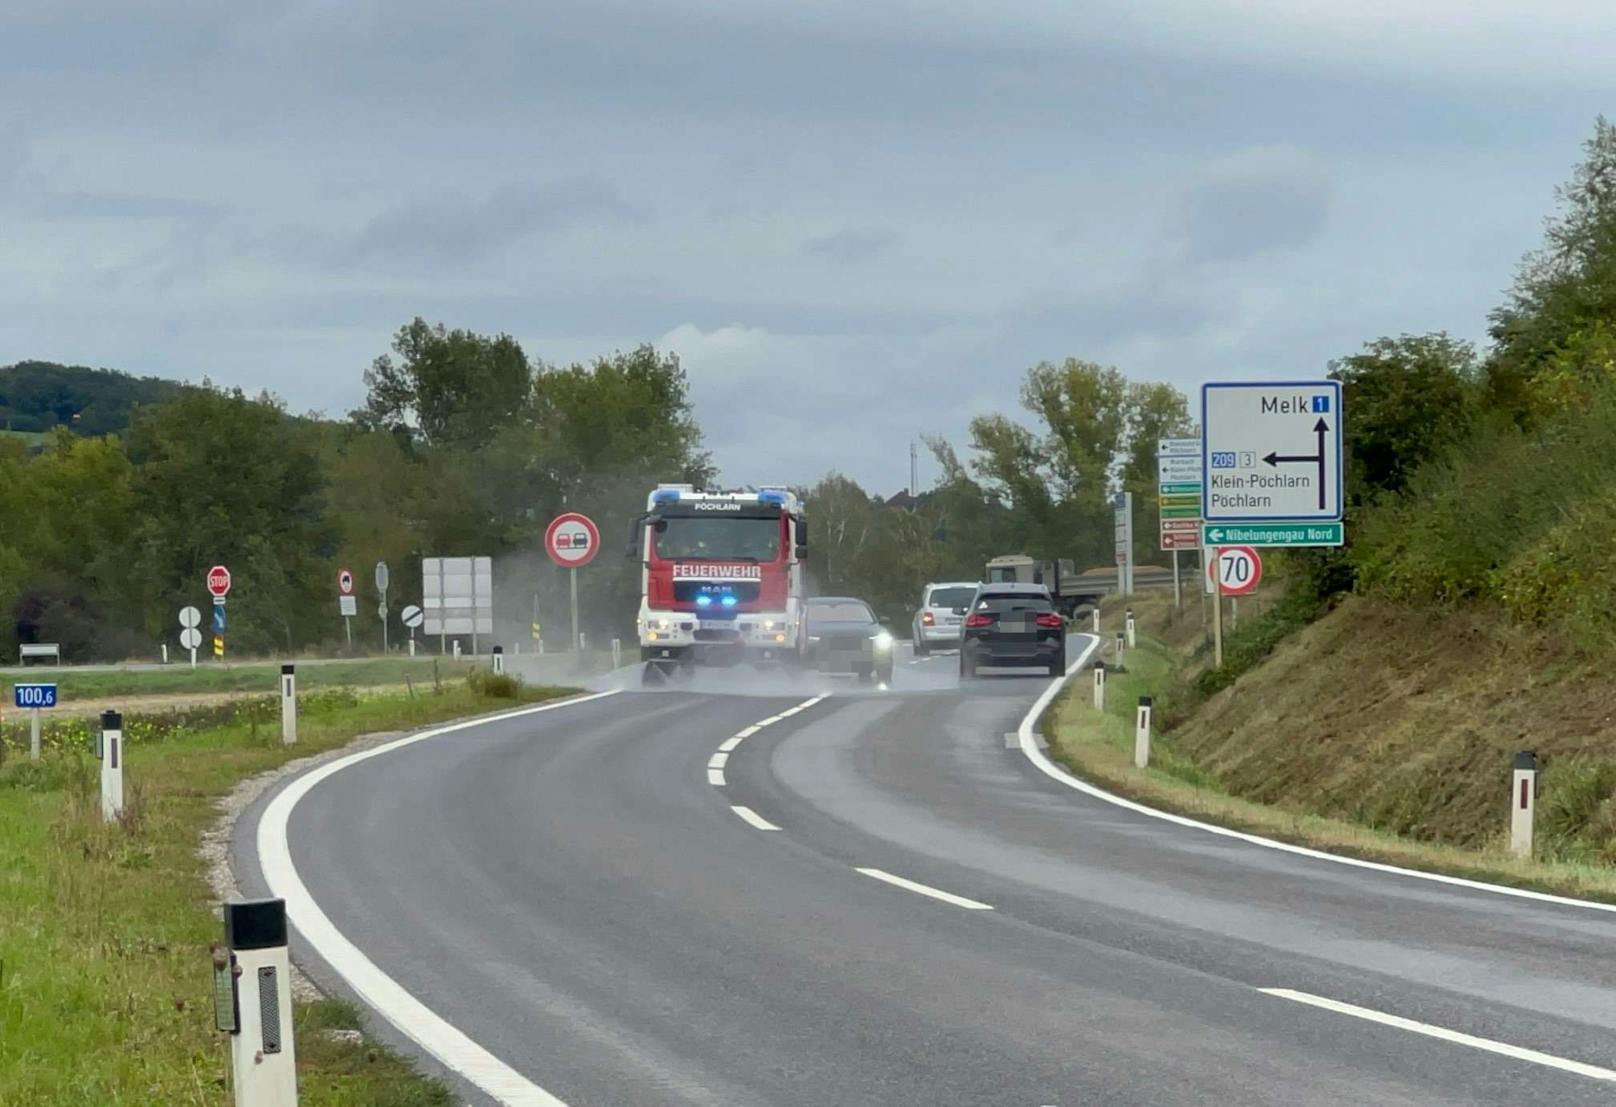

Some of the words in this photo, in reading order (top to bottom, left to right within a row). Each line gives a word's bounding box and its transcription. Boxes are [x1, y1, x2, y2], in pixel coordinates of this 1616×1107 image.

[1261, 396, 1308, 414] Melk
[1212, 453, 1235, 468] 209
[1211, 473, 1310, 489] Klein-Pöchlarn
[1211, 492, 1272, 508] Pöchlarn
[1226, 528, 1305, 543] Nibelungengau
[1307, 527, 1333, 540] Nord
[672, 564, 762, 577] FEUERWEHR
[1221, 556, 1249, 583] 70
[209, 575, 228, 588] STOP
[17, 687, 53, 706] 100,6
